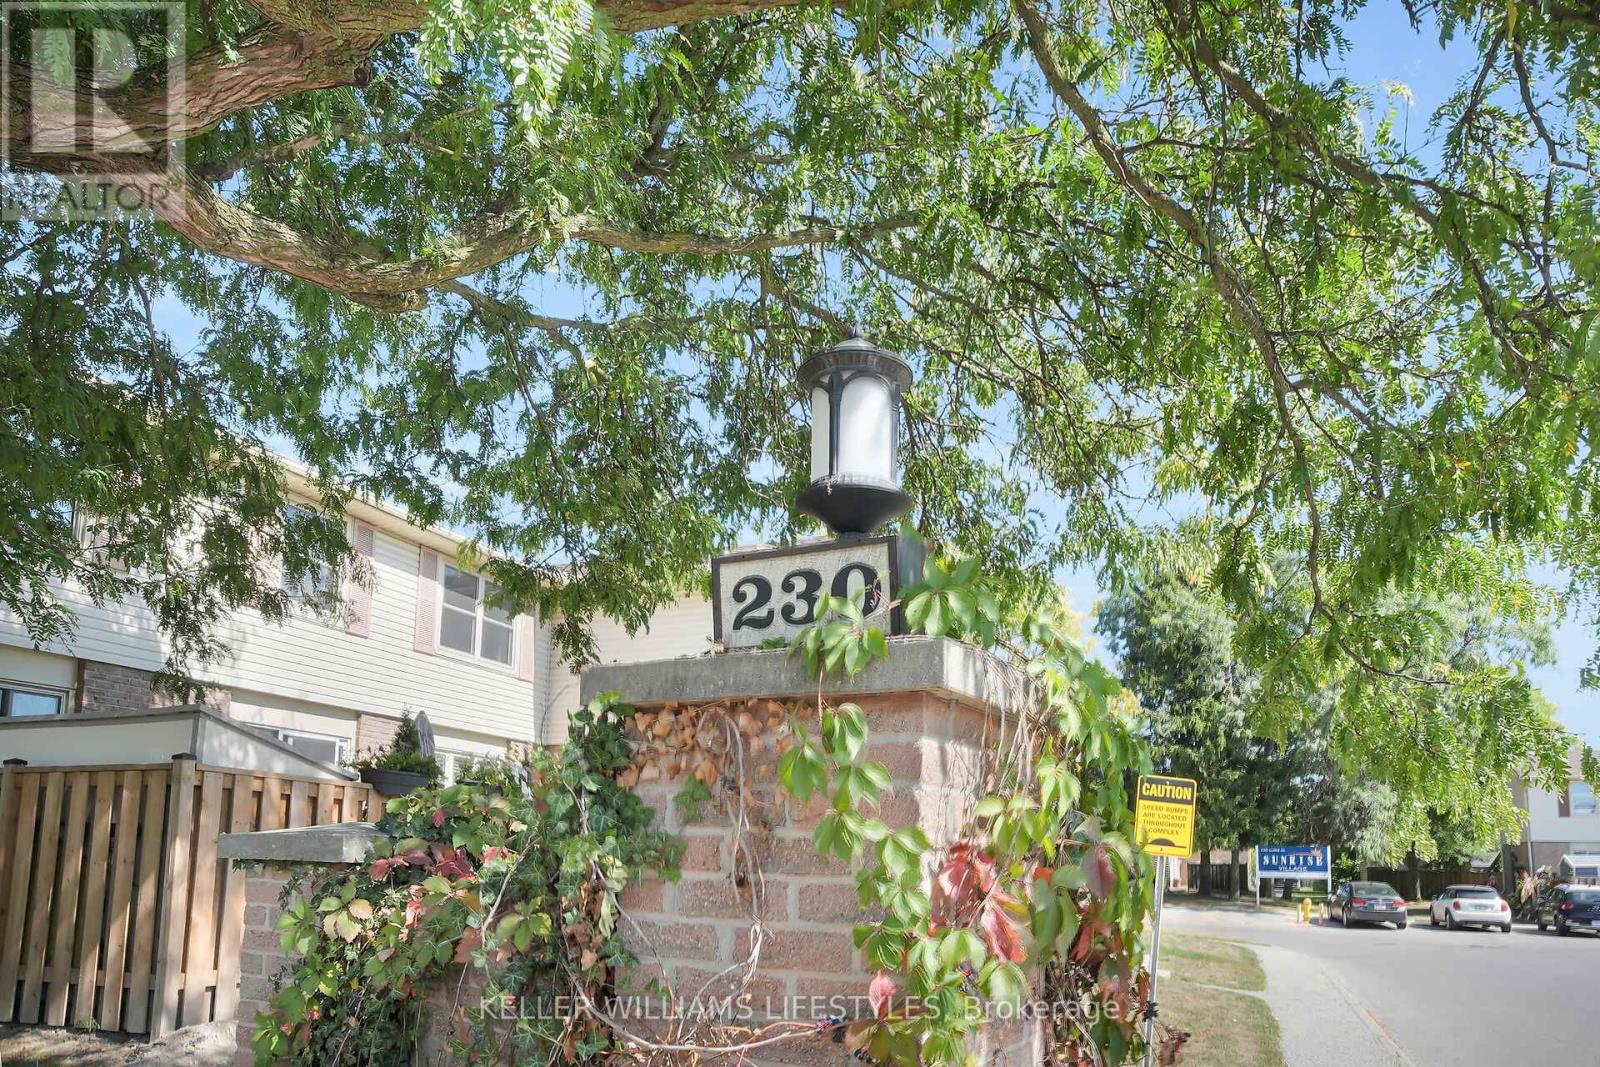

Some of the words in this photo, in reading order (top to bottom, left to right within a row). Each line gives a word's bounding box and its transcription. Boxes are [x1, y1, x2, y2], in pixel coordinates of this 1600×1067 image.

[732, 562, 882, 630] 230
[1142, 783, 1192, 800] CAUTION
[1263, 854, 1323, 867] SUNRISE
